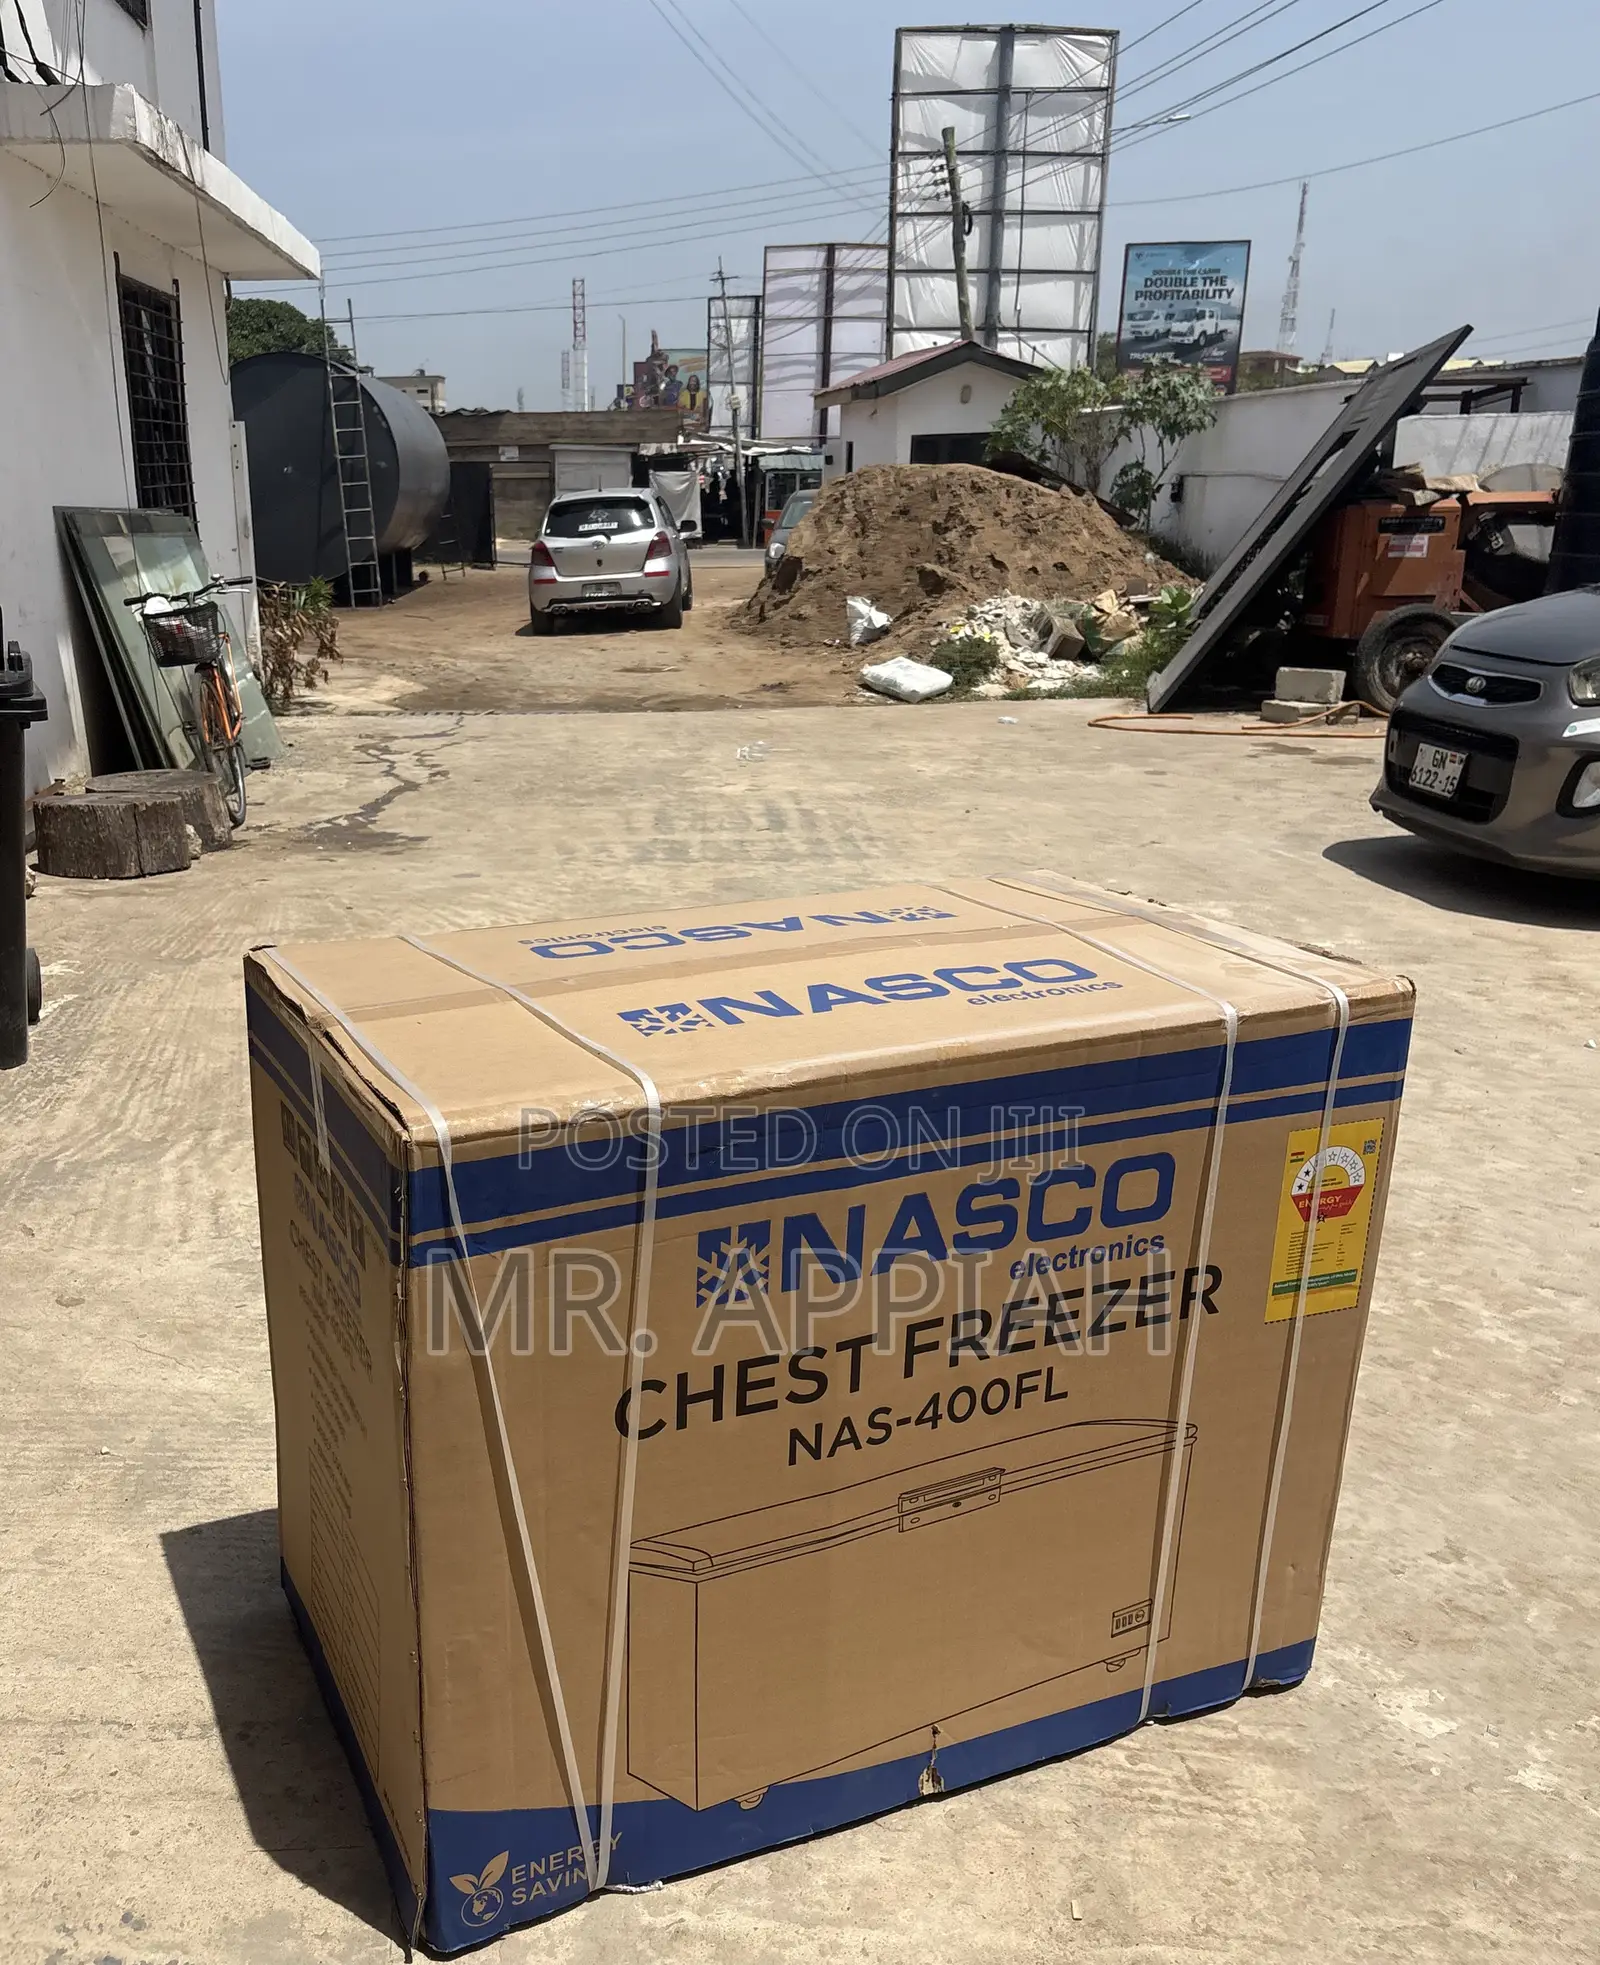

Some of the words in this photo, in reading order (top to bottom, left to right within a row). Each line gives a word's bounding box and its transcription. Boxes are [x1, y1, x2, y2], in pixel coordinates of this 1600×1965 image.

[1135, 288, 1234, 301] PROFITABILITY
[1144, 276, 1198, 288] DOUBLE
[1202, 275, 1228, 287] THE
[1432, 749, 1448, 770] GN
[1410, 765, 1458, 795] 6122-15
[518, 925, 667, 945] electronics
[529, 911, 889, 959] NASCO
[698, 959, 1098, 1025] NASCO
[966, 979, 1123, 1006] electronics
[1299, 1195, 1342, 1208] ENRGY
[781, 1152, 1176, 1293] NASCO
[1009, 1234, 1165, 1279] electronics
[615, 1333, 877, 1441] CHEST
[904, 1265, 1222, 1379] FREEZER
[788, 1366, 1069, 1466] NAS-400FL
[511, 1864, 594, 1906] SAVIN
